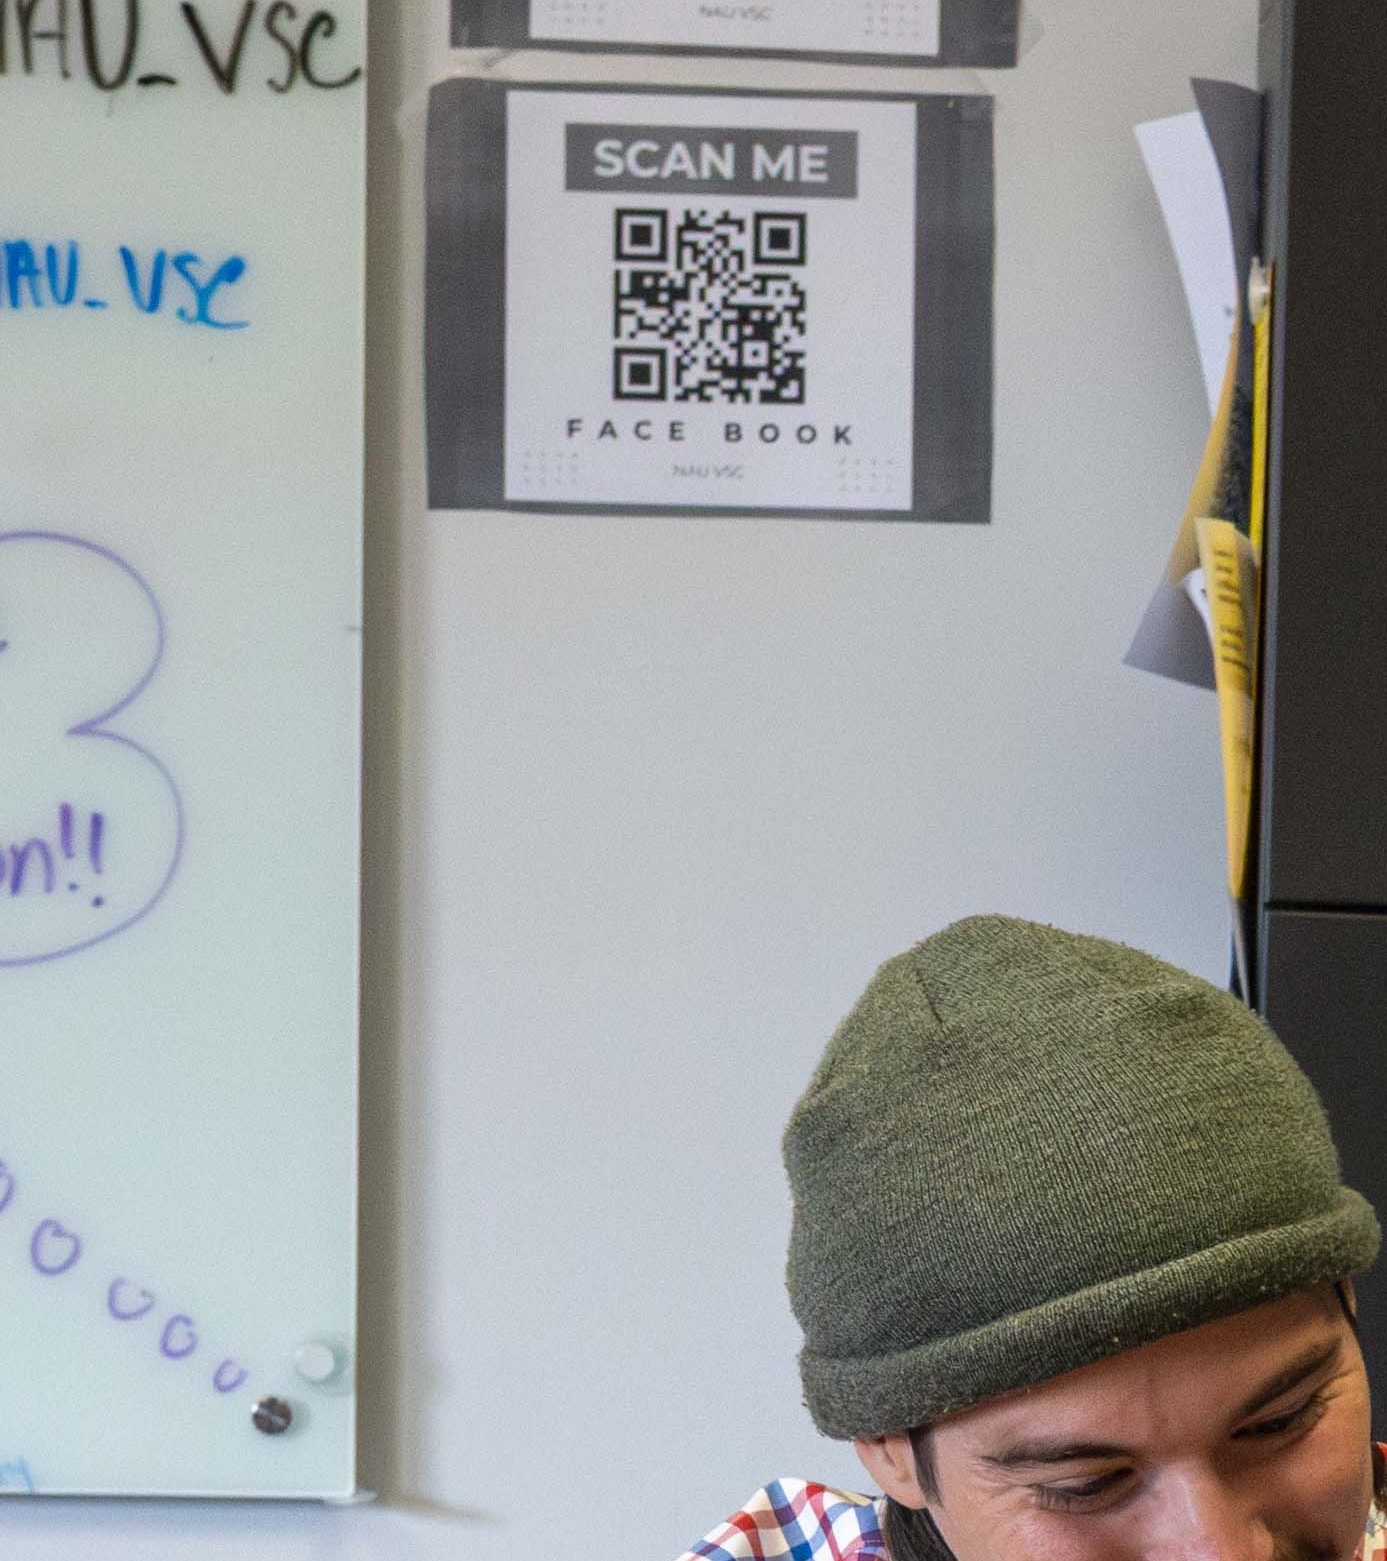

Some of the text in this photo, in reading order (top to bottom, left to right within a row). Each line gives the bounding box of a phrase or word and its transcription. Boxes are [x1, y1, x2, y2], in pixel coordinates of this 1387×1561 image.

[594, 138, 830, 183] SCAN ME
[566, 418, 853, 446] FACE BOOK
[0, 801, 105, 908] n!!
